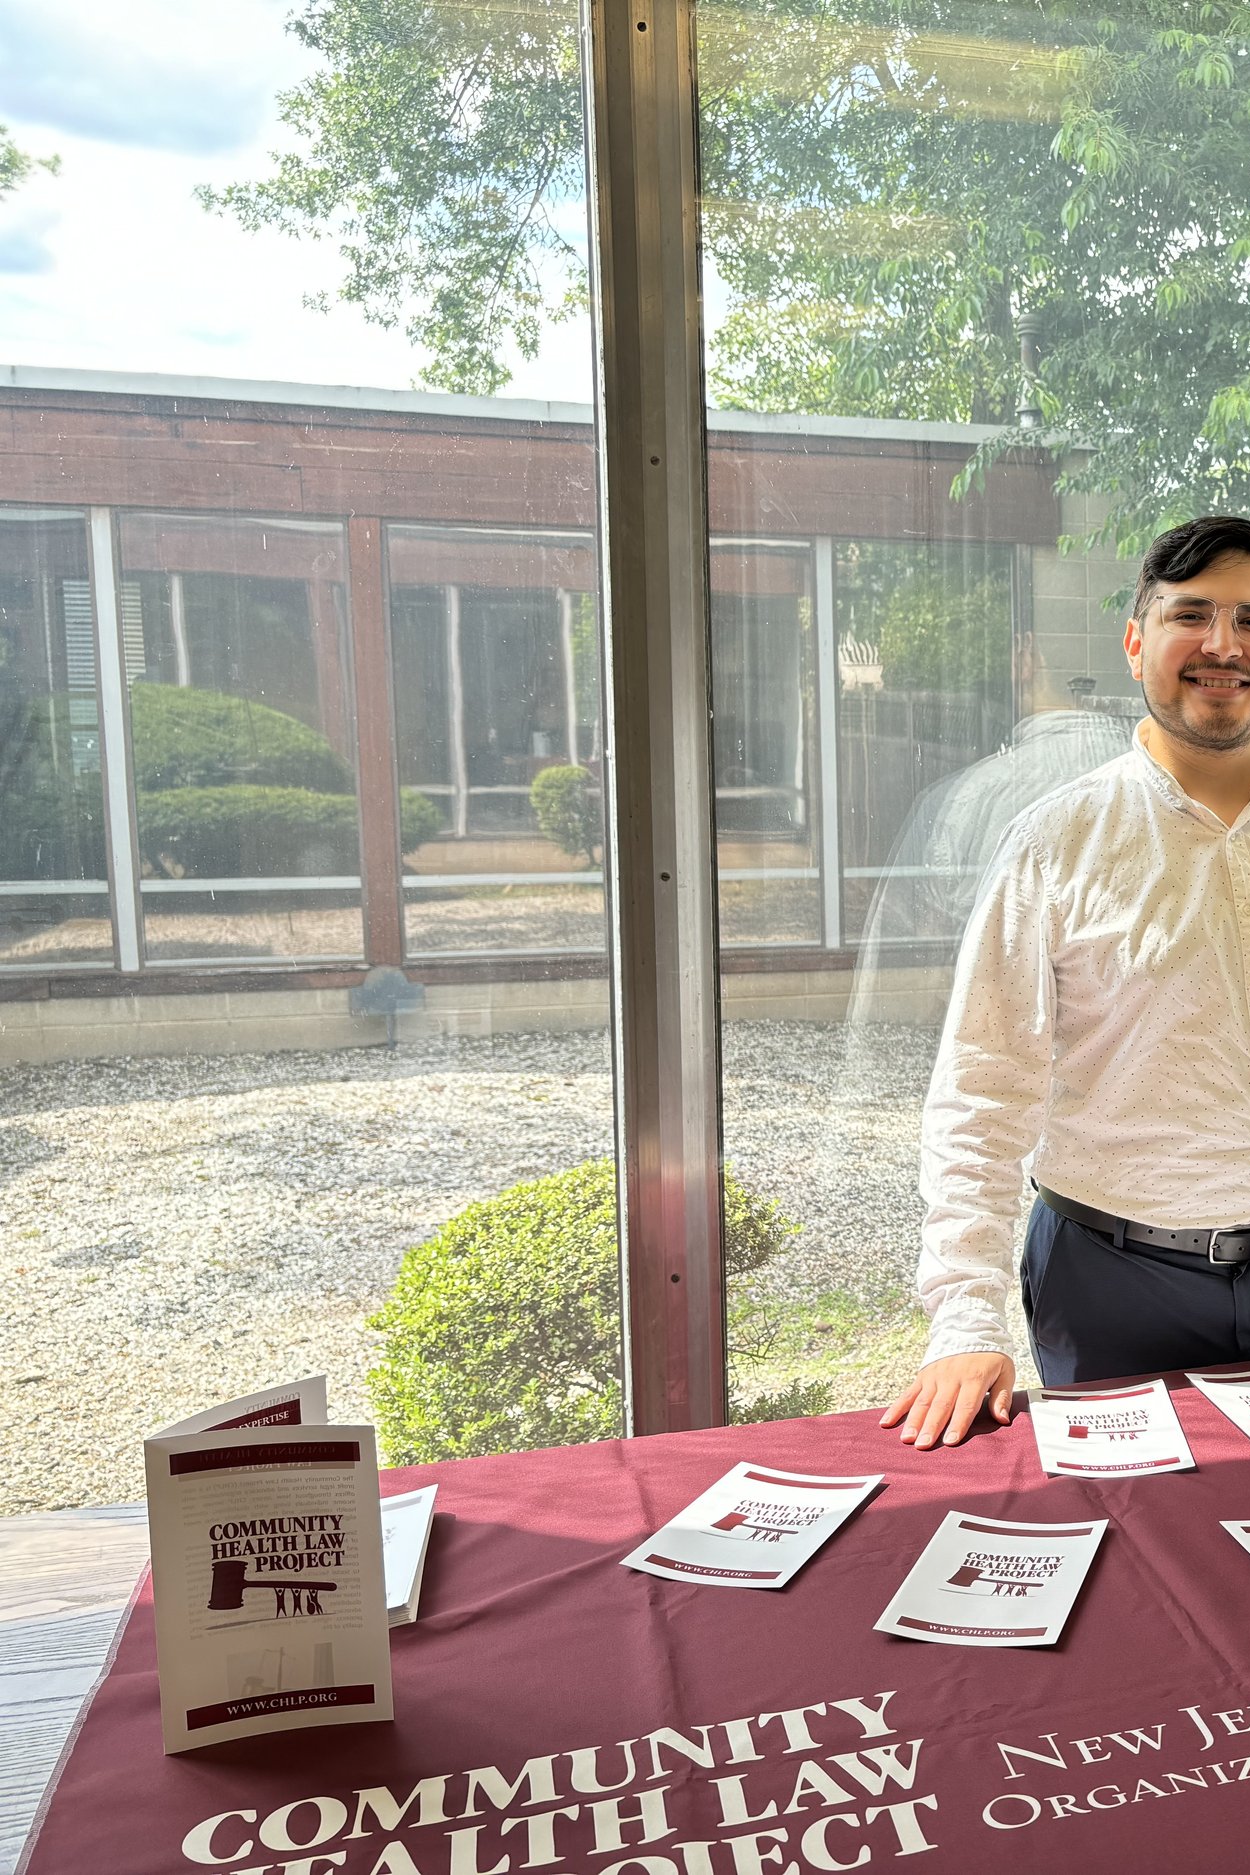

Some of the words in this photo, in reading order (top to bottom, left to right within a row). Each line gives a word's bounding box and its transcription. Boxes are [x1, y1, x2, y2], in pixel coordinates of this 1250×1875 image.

[734, 1506, 789, 1518] HEALTH
[793, 1512, 824, 1521] LAW
[738, 1499, 829, 1513] COMMUNITY
[209, 1514, 344, 1541] COMMUNITY
[753, 1516, 818, 1527] PROJECT
[211, 1535, 298, 1560] HEALTH
[304, 1532, 346, 1550] LAW
[255, 1550, 345, 1572] PROJECT
[963, 1558, 1025, 1570] HEALTH
[1030, 1562, 1063, 1572] LAW
[966, 1551, 1066, 1564] COMMUNITY
[674, 1562, 753, 1578] WWW.CHLP.ORG
[989, 1569, 1059, 1579] PROJECT
[928, 1623, 1016, 1636] WWW.CHLP.ORG
[227, 1692, 338, 1716] WWW.CHLP.ORG
[996, 1723, 1166, 1780] NEW
[181, 1690, 899, 1865] COMMUNITY
[707, 1738, 924, 1828] LAW
